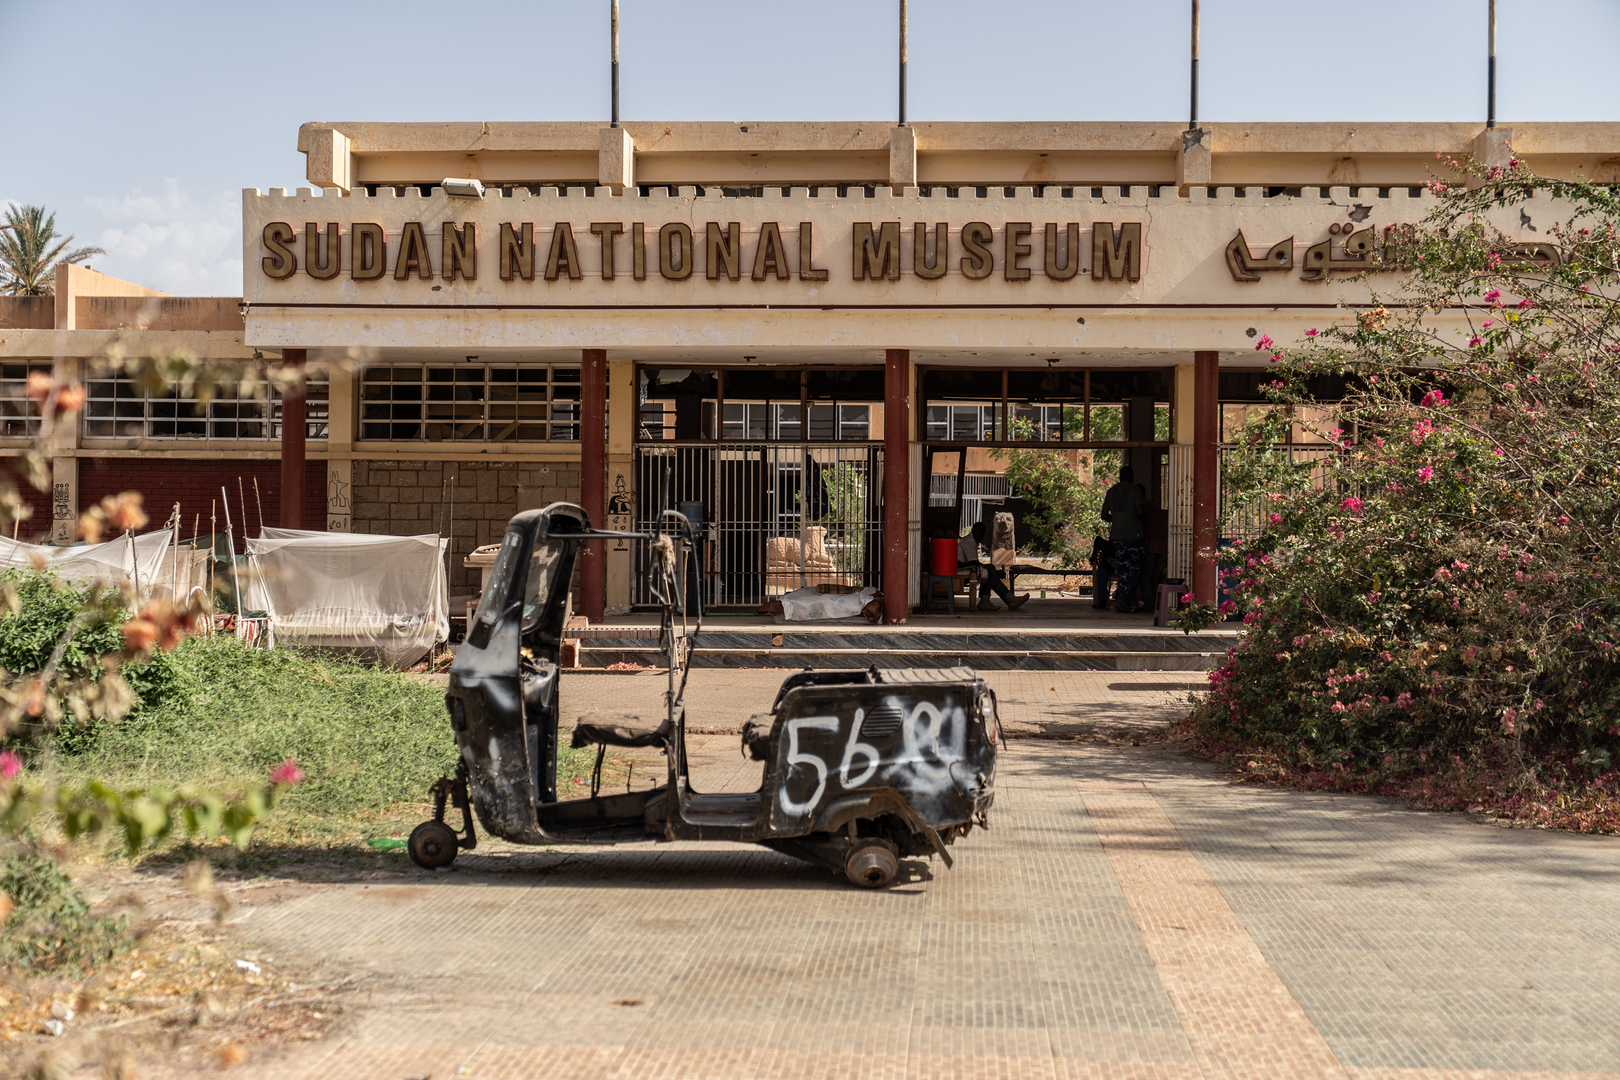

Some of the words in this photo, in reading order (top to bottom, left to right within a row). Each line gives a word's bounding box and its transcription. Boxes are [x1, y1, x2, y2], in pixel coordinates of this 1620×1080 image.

[261, 221, 477, 281] SUDAN
[499, 221, 829, 282] NATIONAL
[852, 221, 1142, 282] MUSEUM
